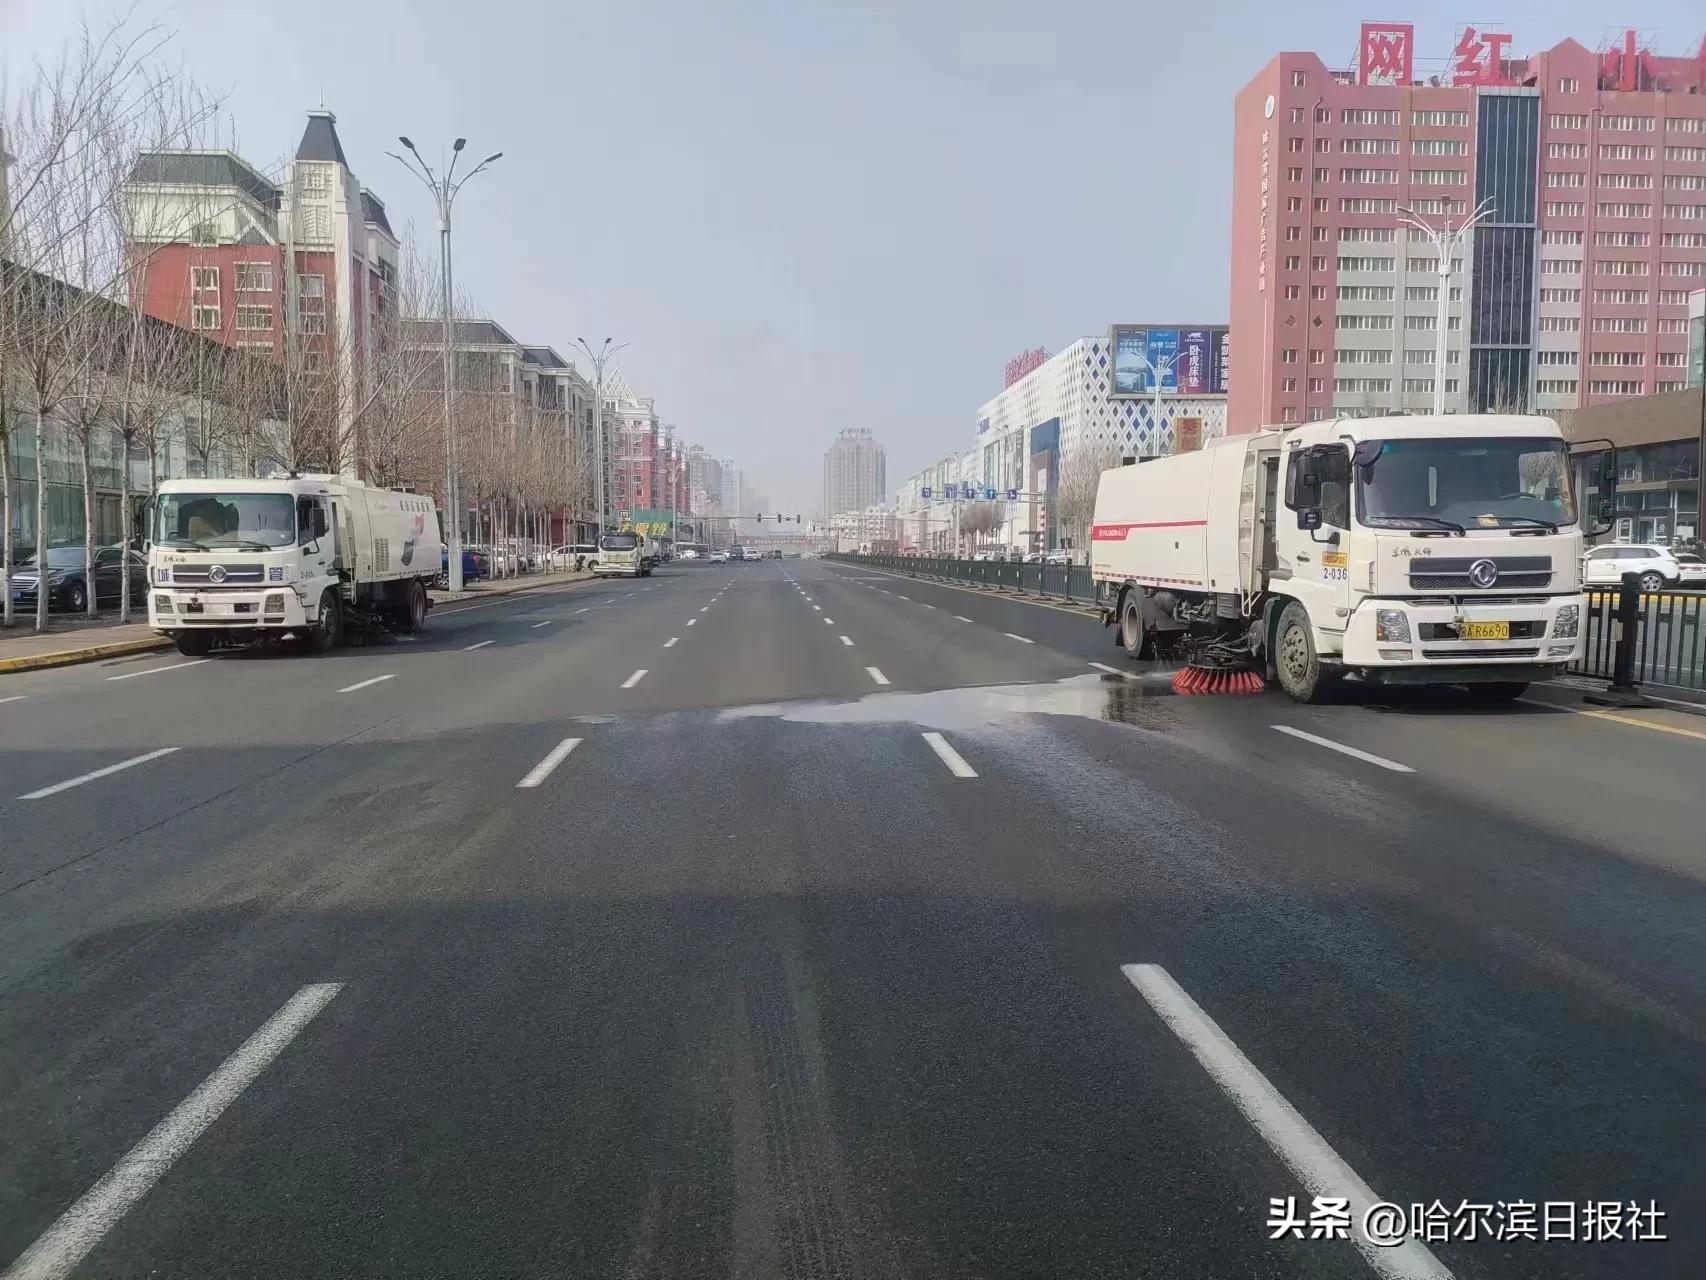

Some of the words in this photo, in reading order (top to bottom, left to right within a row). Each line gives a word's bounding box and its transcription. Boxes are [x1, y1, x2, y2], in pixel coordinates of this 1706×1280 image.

[1360, 22, 1706, 92] 网红小
[1188, 344, 1201, 387] 卧虎床垫
[1323, 567, 1348, 580] 2-036
